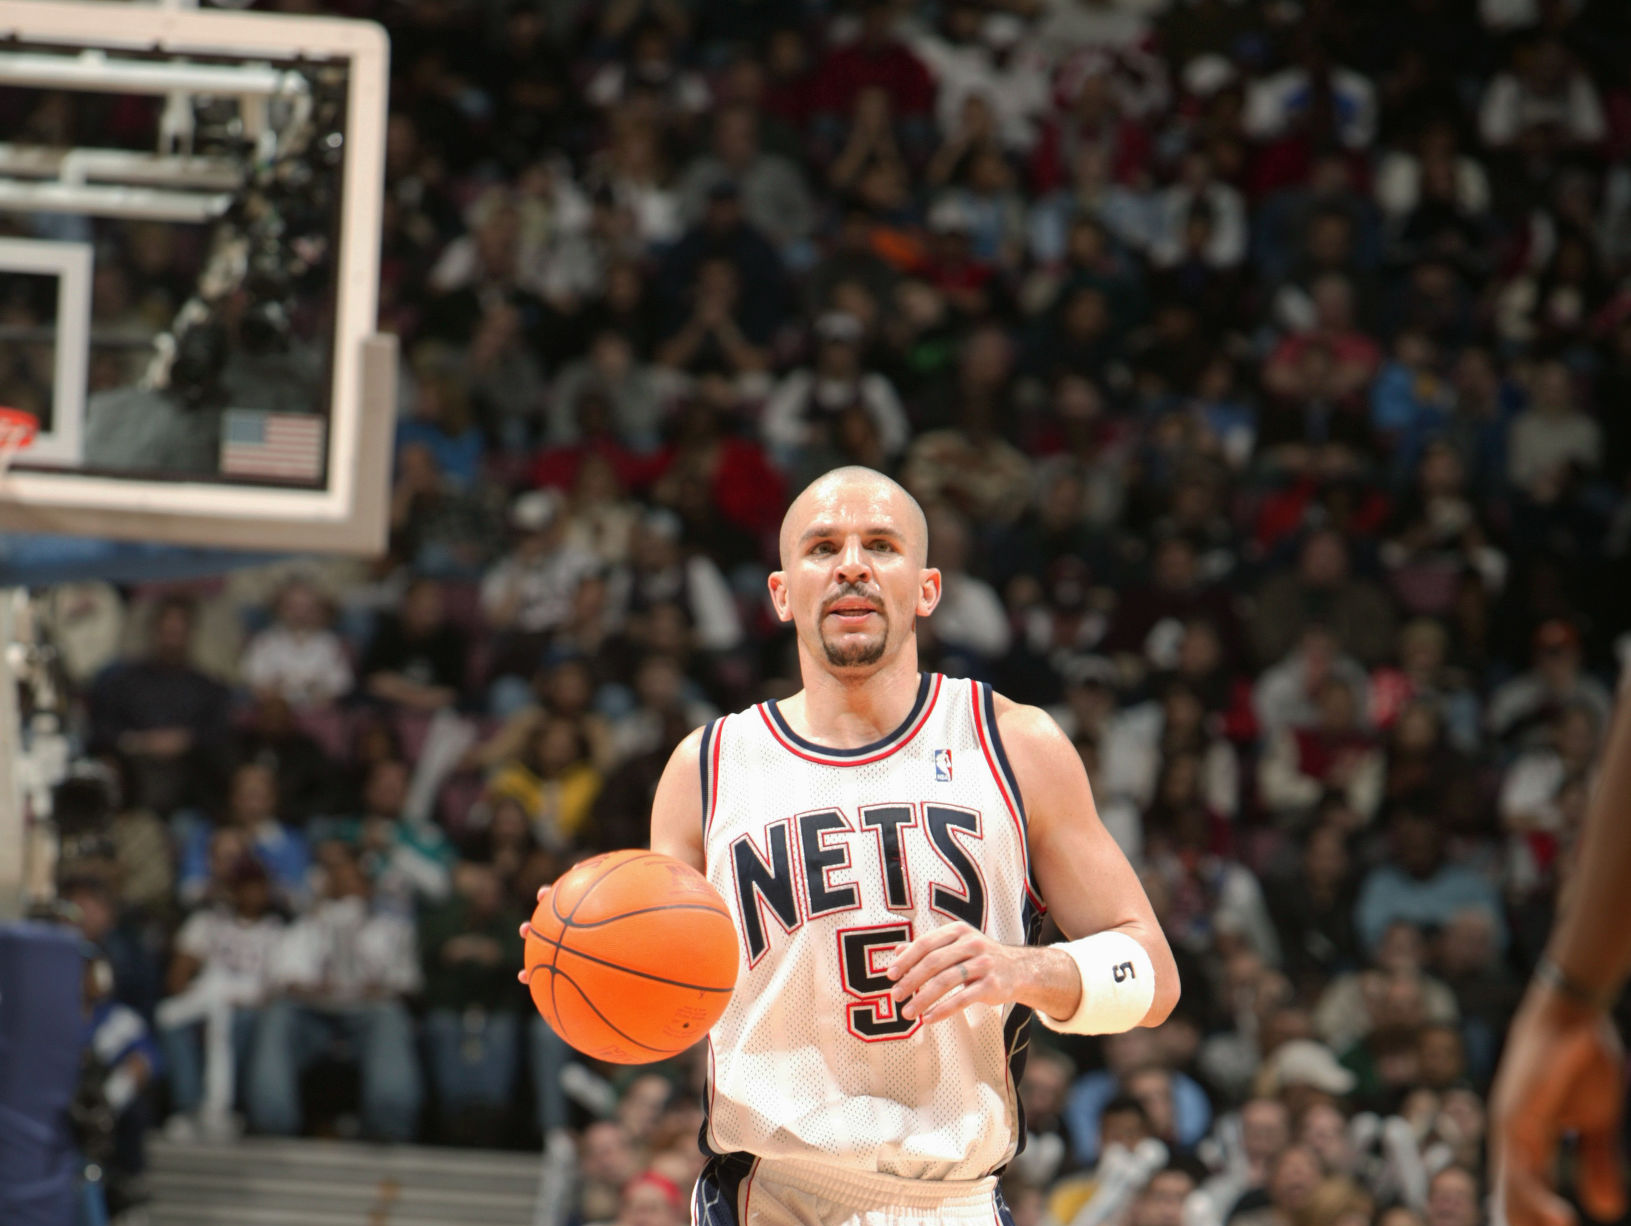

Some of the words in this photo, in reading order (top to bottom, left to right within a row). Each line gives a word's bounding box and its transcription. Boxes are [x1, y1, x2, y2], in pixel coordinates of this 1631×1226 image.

[729, 801, 989, 971] NETS
[836, 921, 924, 1044] 5
[1112, 961, 1136, 983] 5
